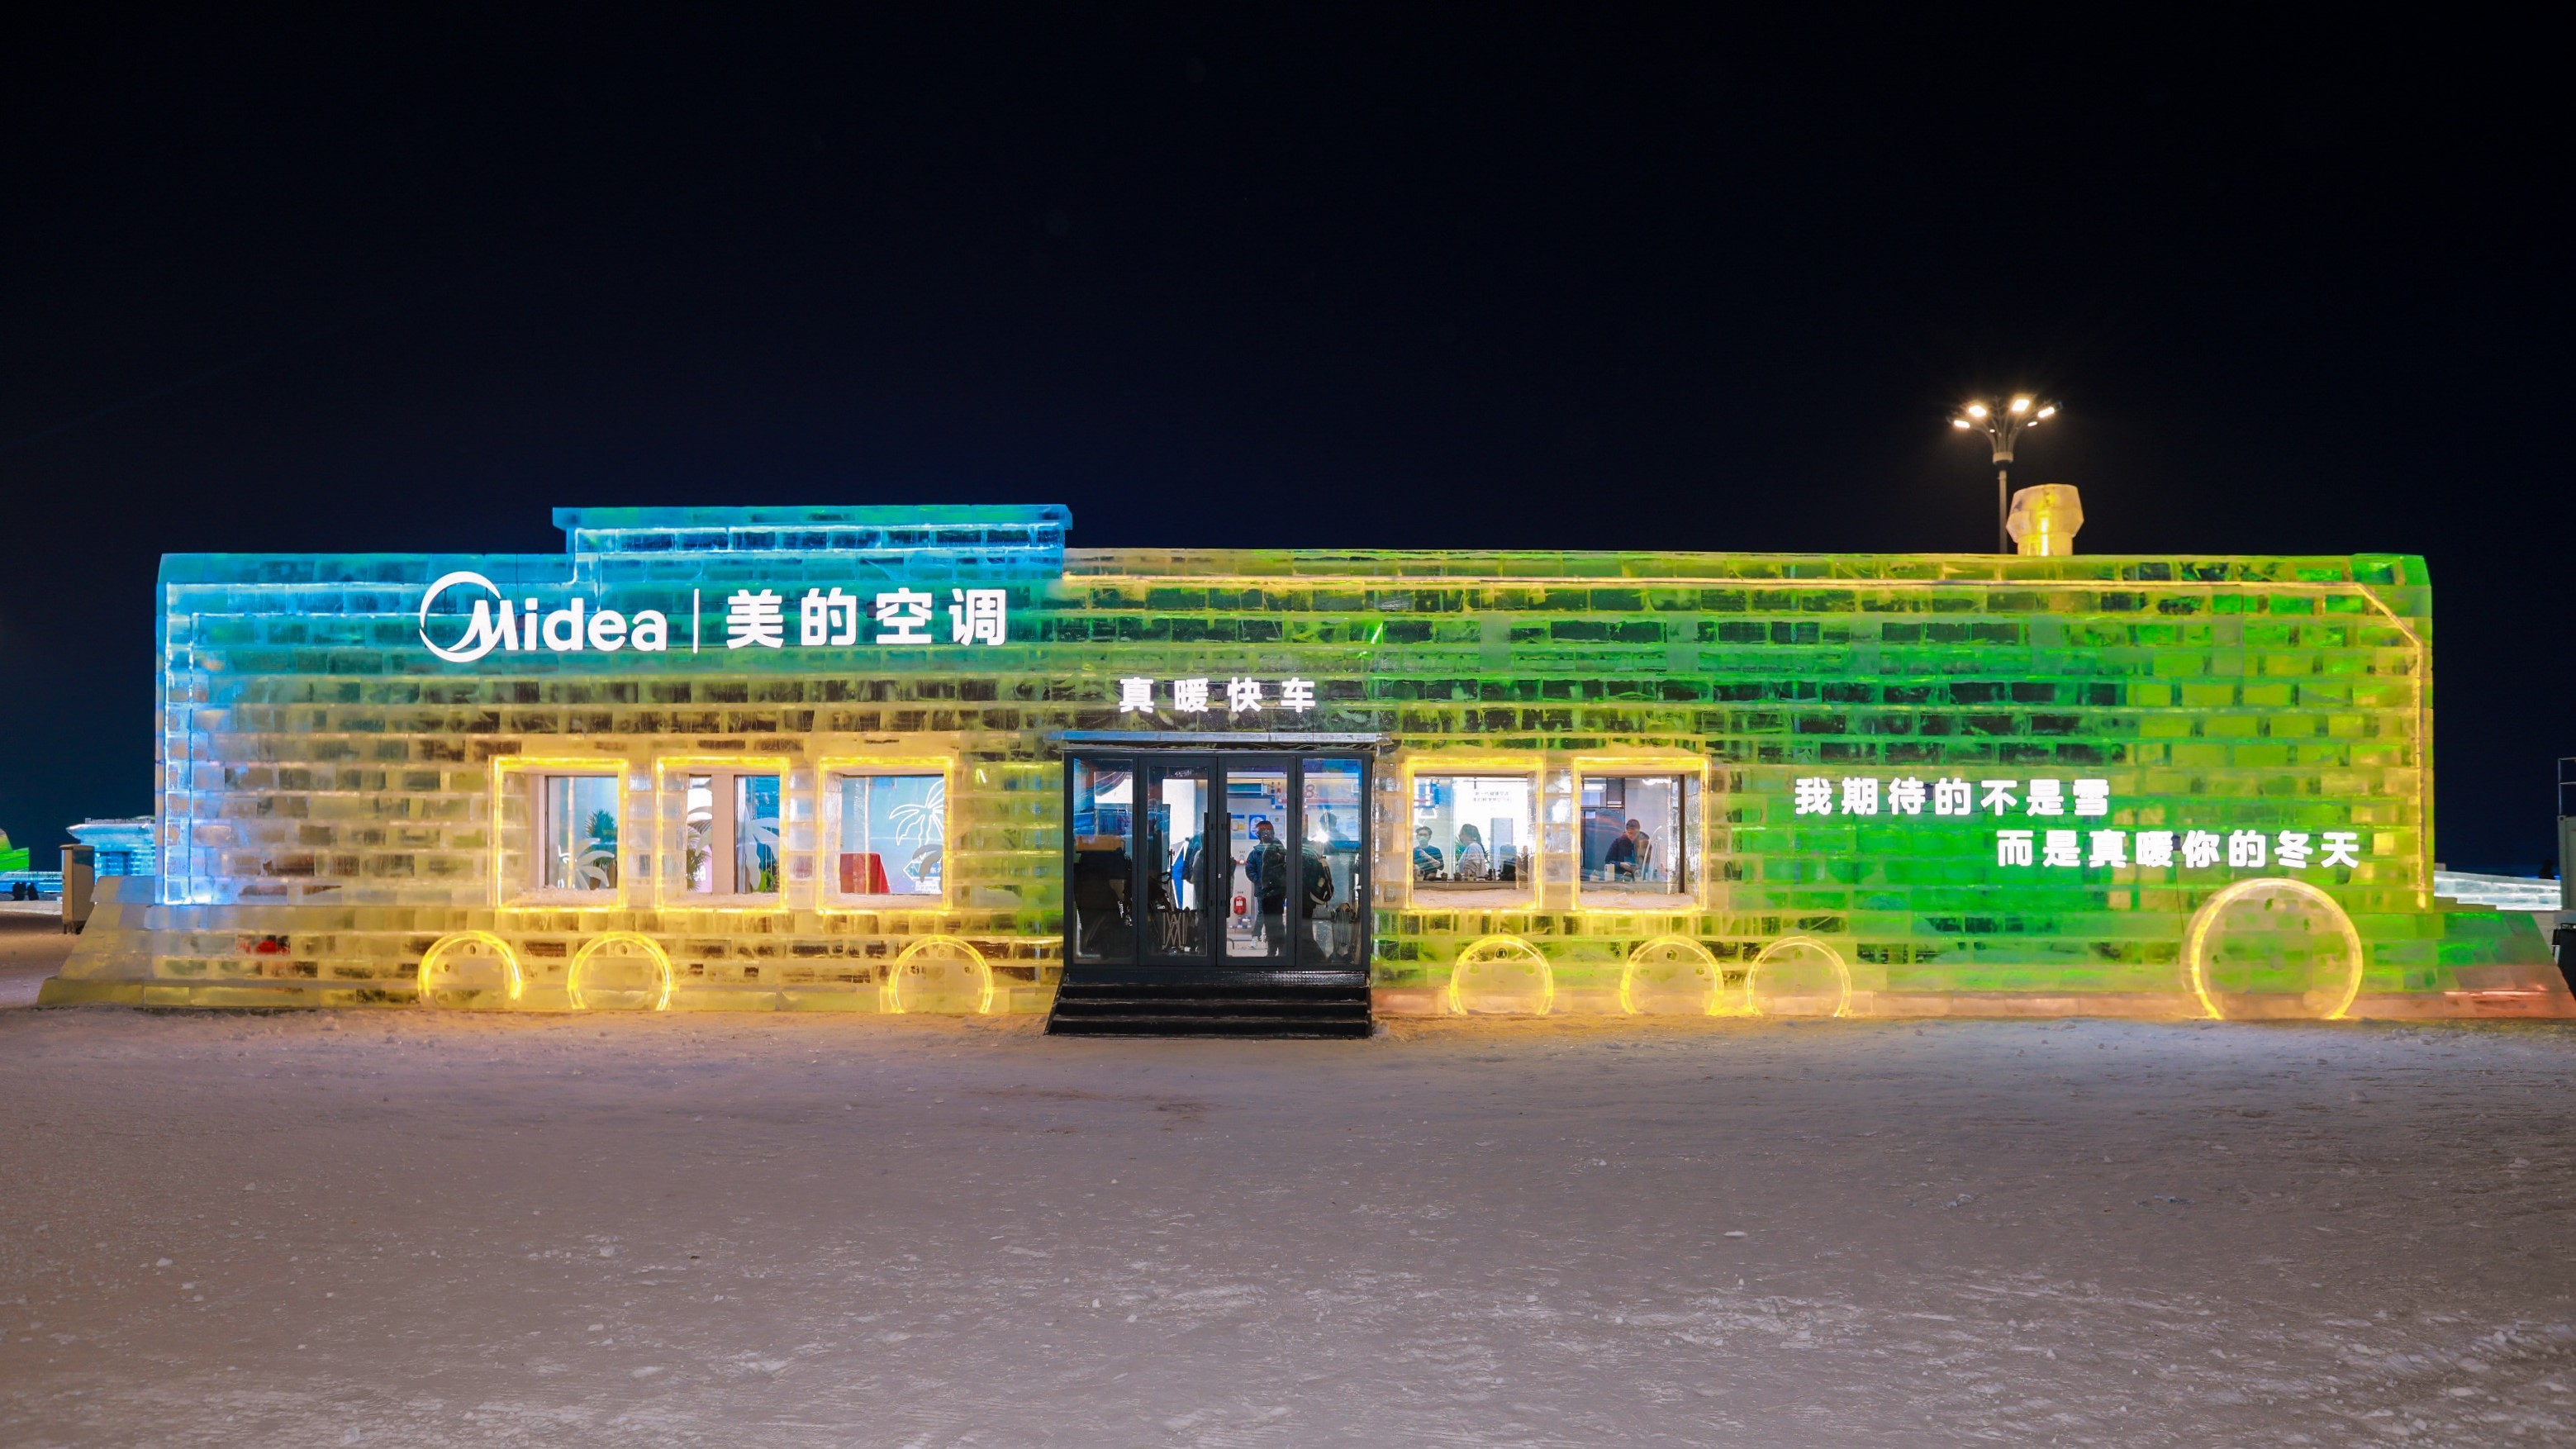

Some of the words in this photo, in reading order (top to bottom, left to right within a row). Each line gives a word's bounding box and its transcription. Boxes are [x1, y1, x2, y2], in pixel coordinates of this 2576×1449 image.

[420, 572, 667, 663] Midea
[726, 587, 1006, 649] 美的空调
[1119, 677, 1316, 713] 真暖快车
[1794, 777, 2110, 816] 我期待的不是雪
[1997, 829, 2360, 868] 而是真暖你的冬天
